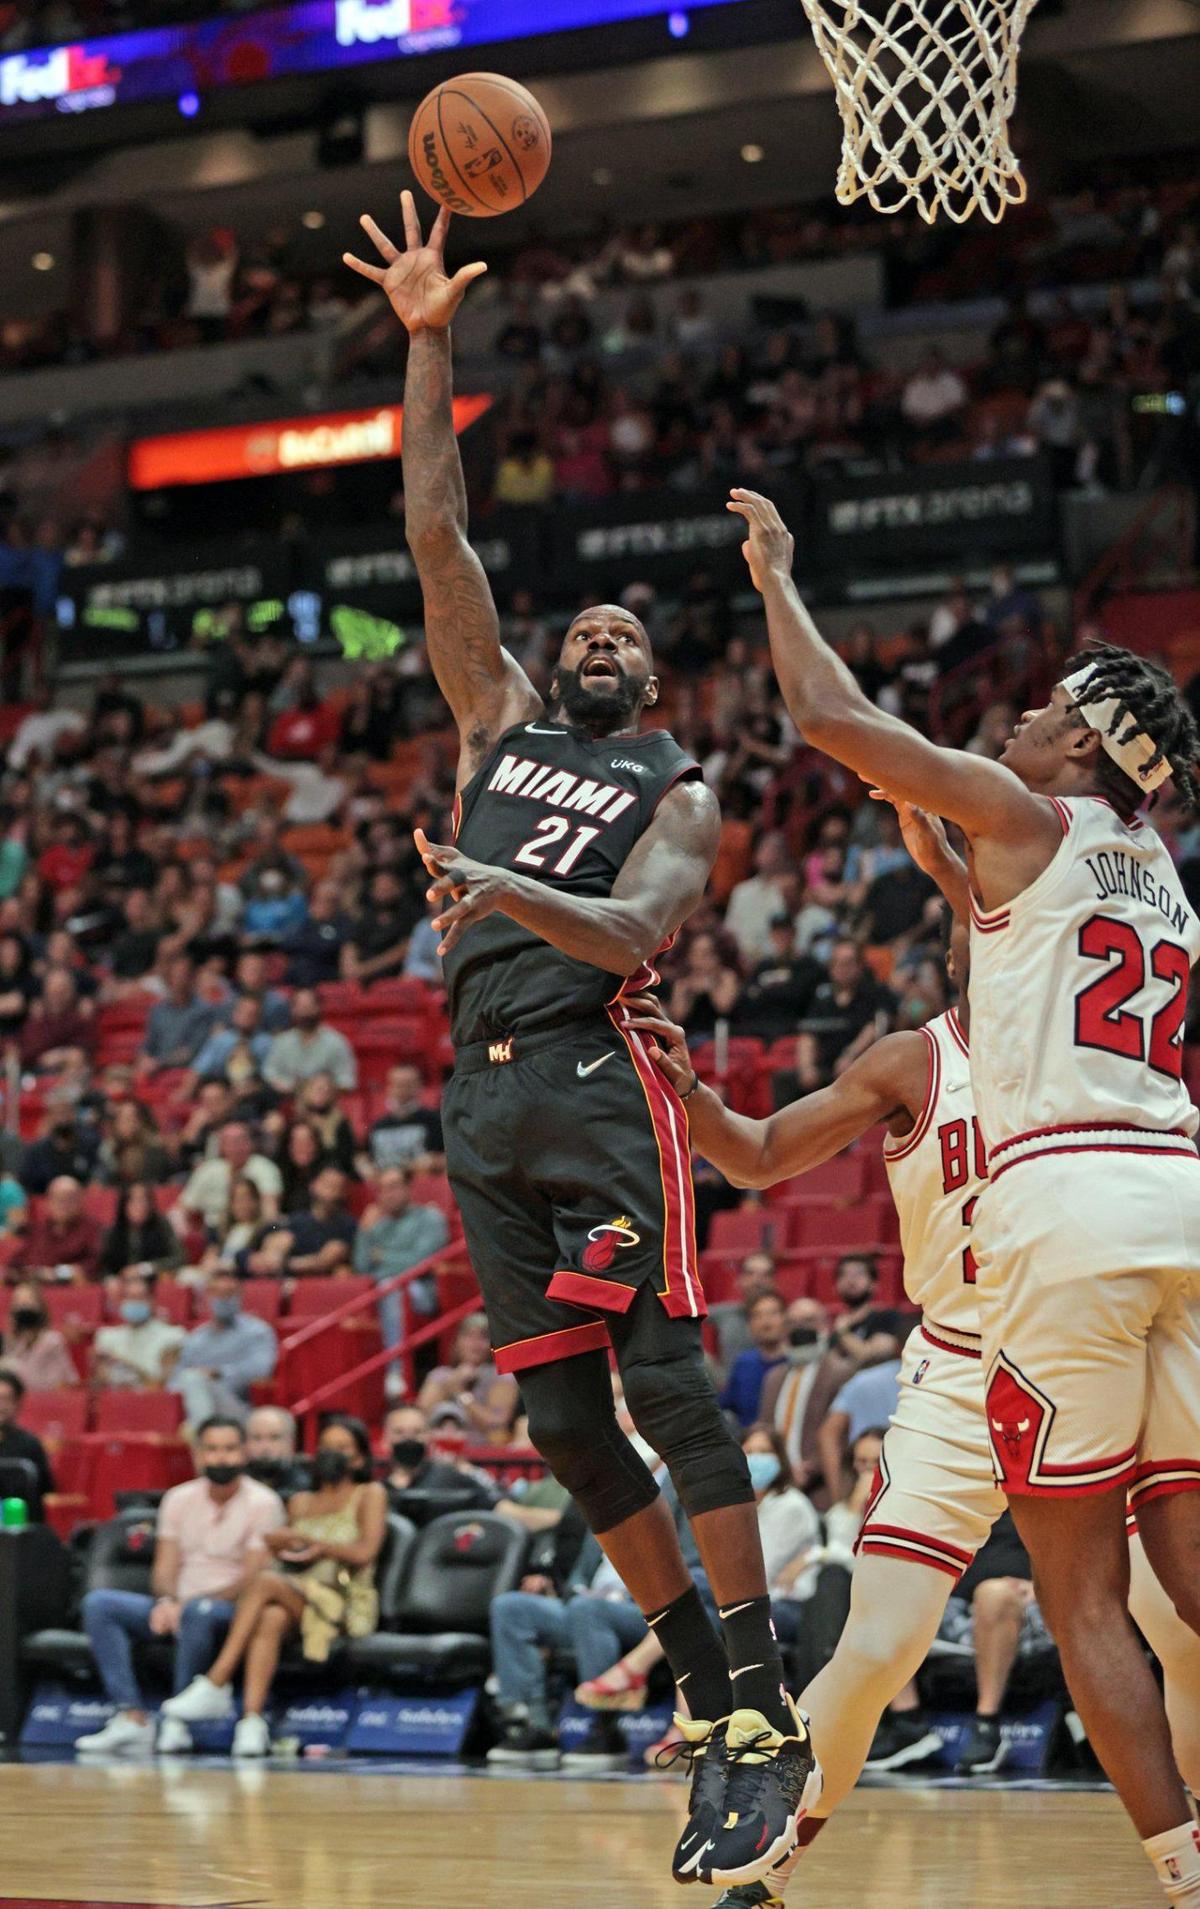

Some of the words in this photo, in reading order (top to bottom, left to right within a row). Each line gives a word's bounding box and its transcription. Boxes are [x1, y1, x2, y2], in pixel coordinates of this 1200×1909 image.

[423, 132, 475, 214] Wilson
[487, 754, 639, 824] MIAMI
[610, 758, 645, 774] UKG
[514, 814, 602, 876] 21
[1086, 851, 1190, 937] JOHNSON
[1074, 914, 1192, 1083] 22
